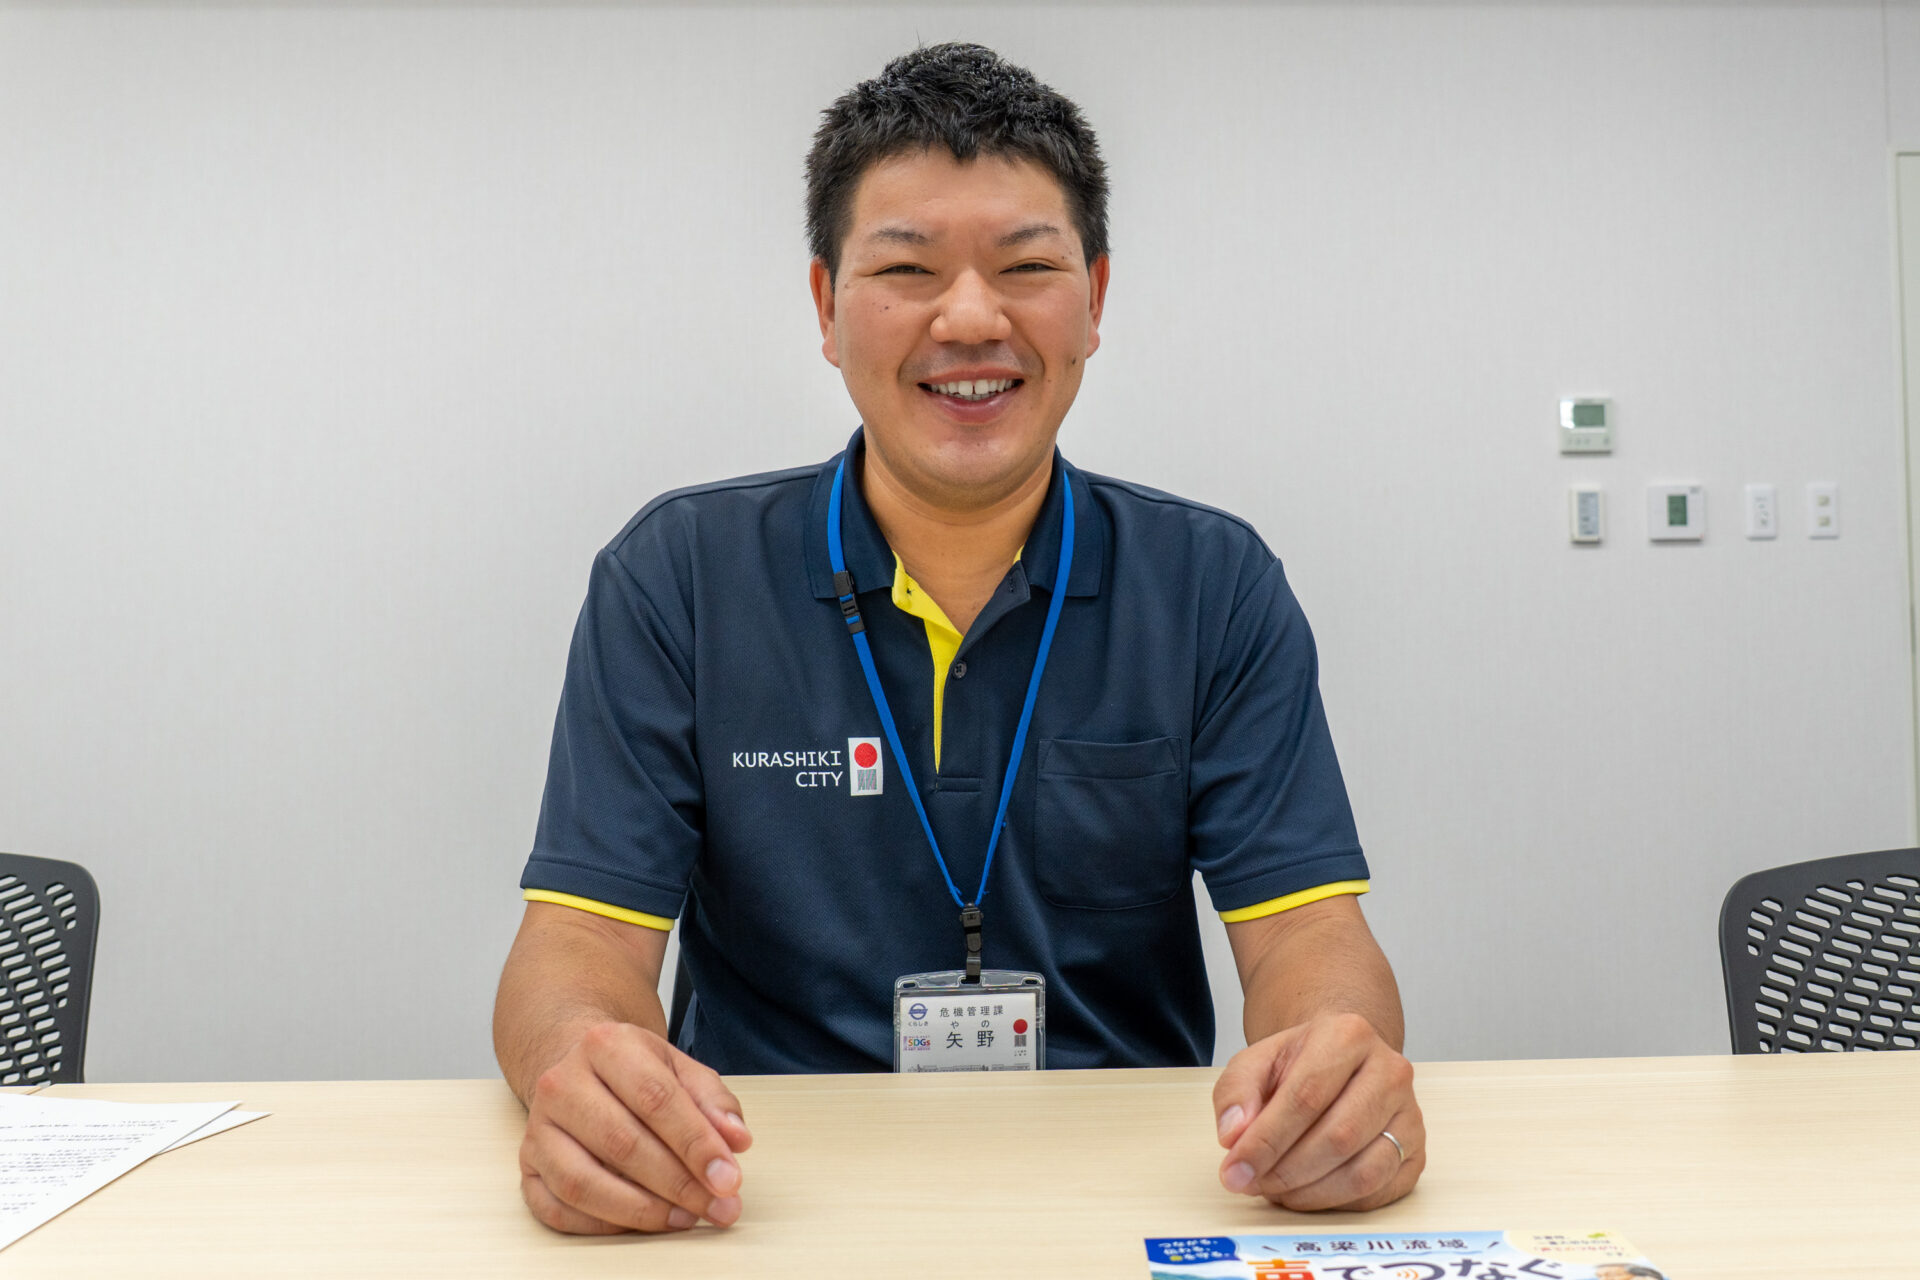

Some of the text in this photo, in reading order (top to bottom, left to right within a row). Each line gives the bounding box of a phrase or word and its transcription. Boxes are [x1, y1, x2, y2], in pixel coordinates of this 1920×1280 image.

[733, 750, 842, 768] KURASHIKI
[795, 771, 843, 787] CITY
[940, 1004, 1004, 1018] 危機管理課
[907, 1038, 931, 1047] SDGs
[1293, 1238, 1468, 1252] 高梁川流域
